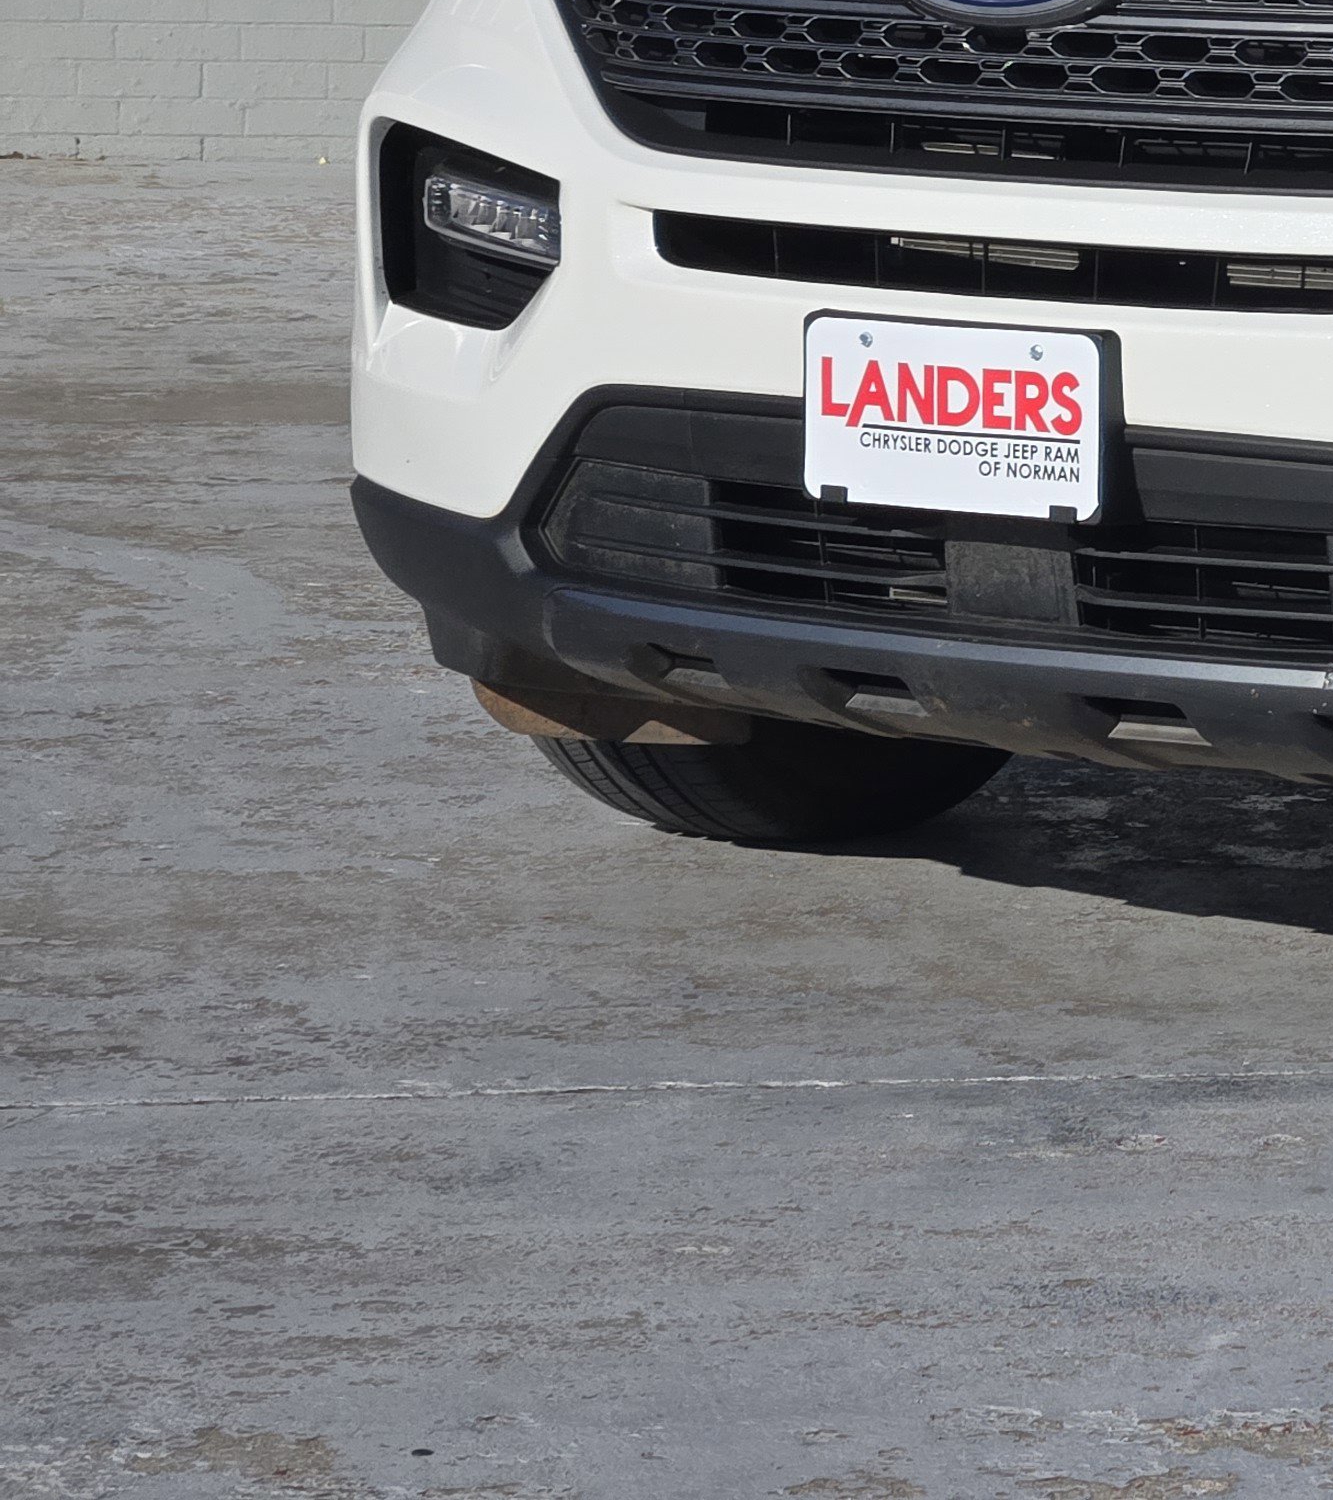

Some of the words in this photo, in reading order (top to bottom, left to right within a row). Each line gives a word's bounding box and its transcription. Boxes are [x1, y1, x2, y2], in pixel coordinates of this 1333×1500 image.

[821, 356, 1083, 435] LANDERS
[860, 432, 932, 454] CHRYSLER
[937, 439, 998, 458] DODGE
[1003, 444, 1039, 461] JEEP
[1045, 446, 1080, 464] RAM
[978, 461, 1002, 478] OF
[1007, 463, 1081, 484] NORMAN
